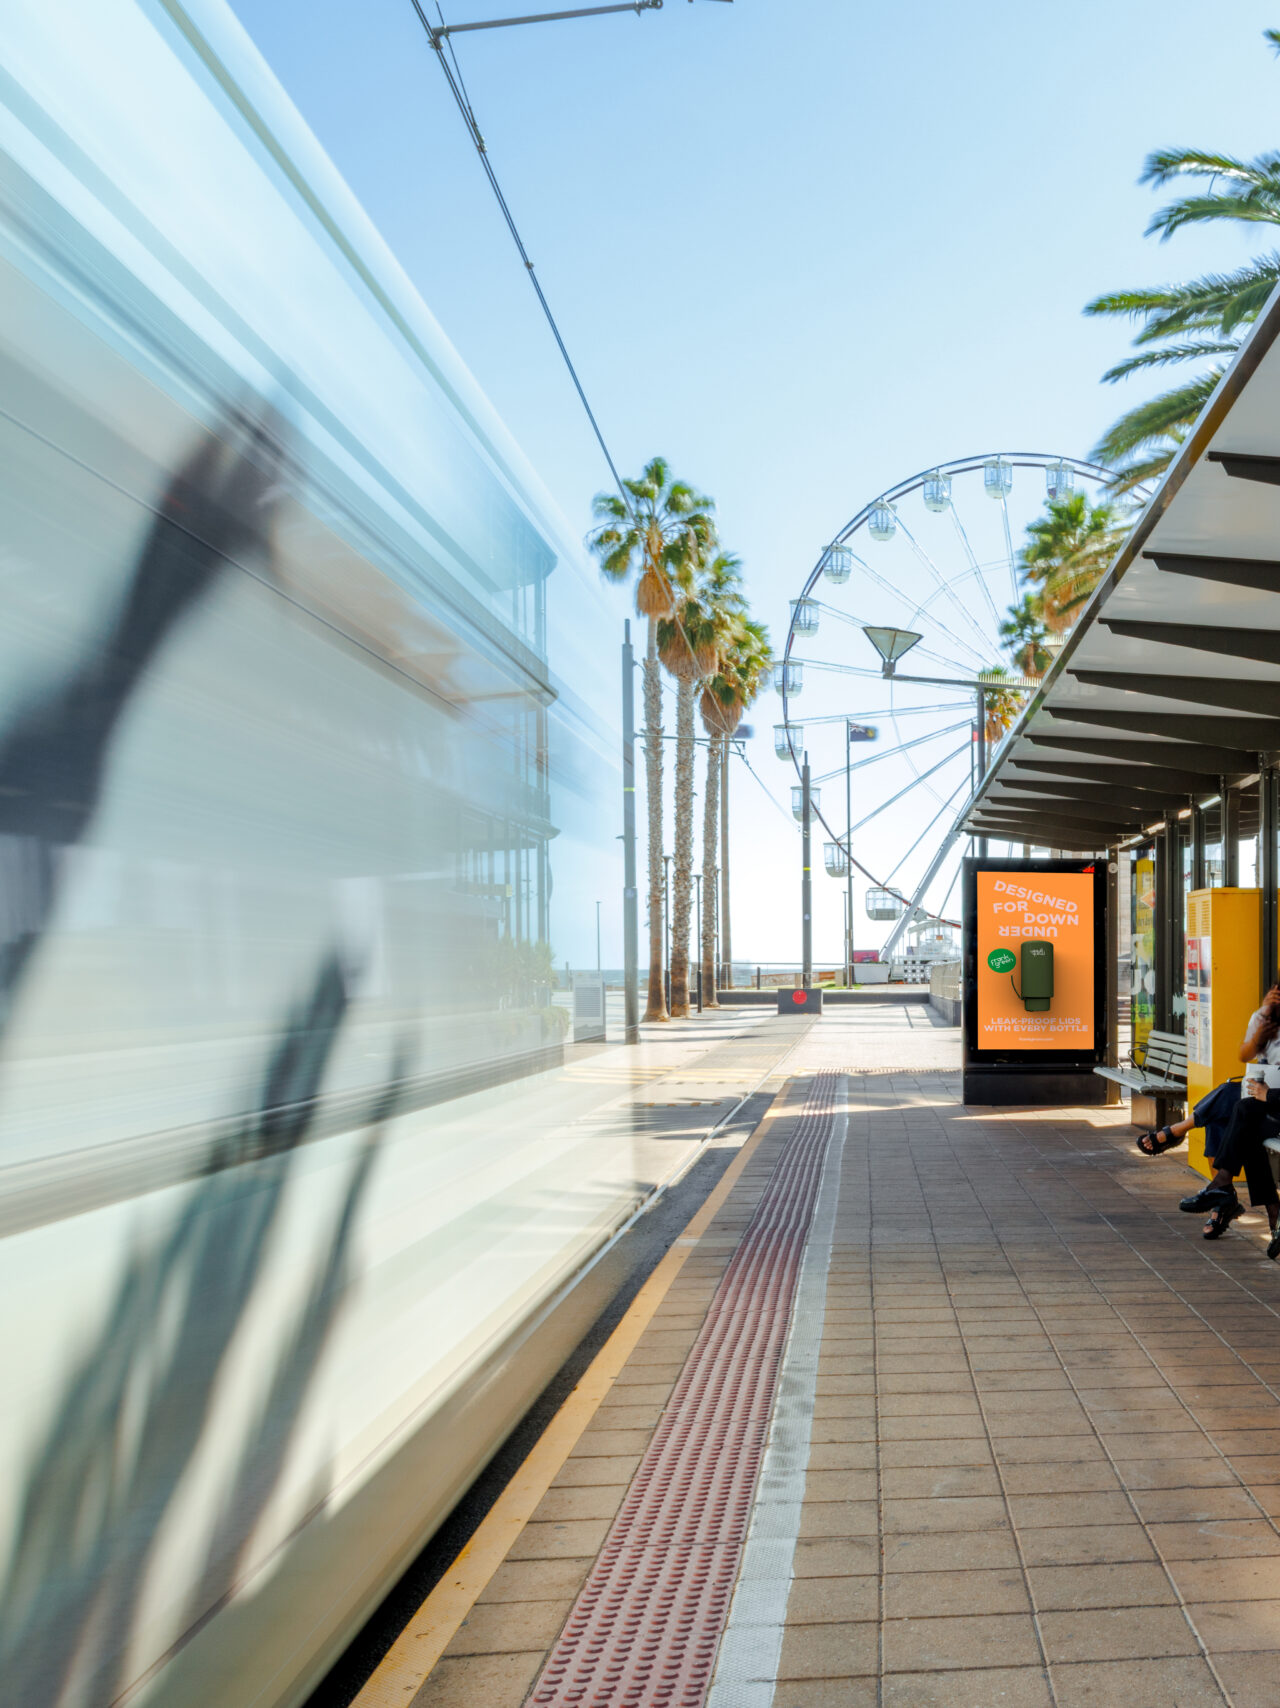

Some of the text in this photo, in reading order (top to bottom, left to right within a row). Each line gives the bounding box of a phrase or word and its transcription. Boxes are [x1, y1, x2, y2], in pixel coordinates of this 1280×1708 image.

[993, 880, 1078, 913] DESIGNED
[993, 901, 1028, 914] FOR
[1023, 912, 1079, 926] DOWN
[998, 925, 1058, 937] UNDER
[991, 1017, 1081, 1025] LEAK-PROOF LIDS
[983, 1024, 1089, 1032] WITH EVERY BOTTLE
